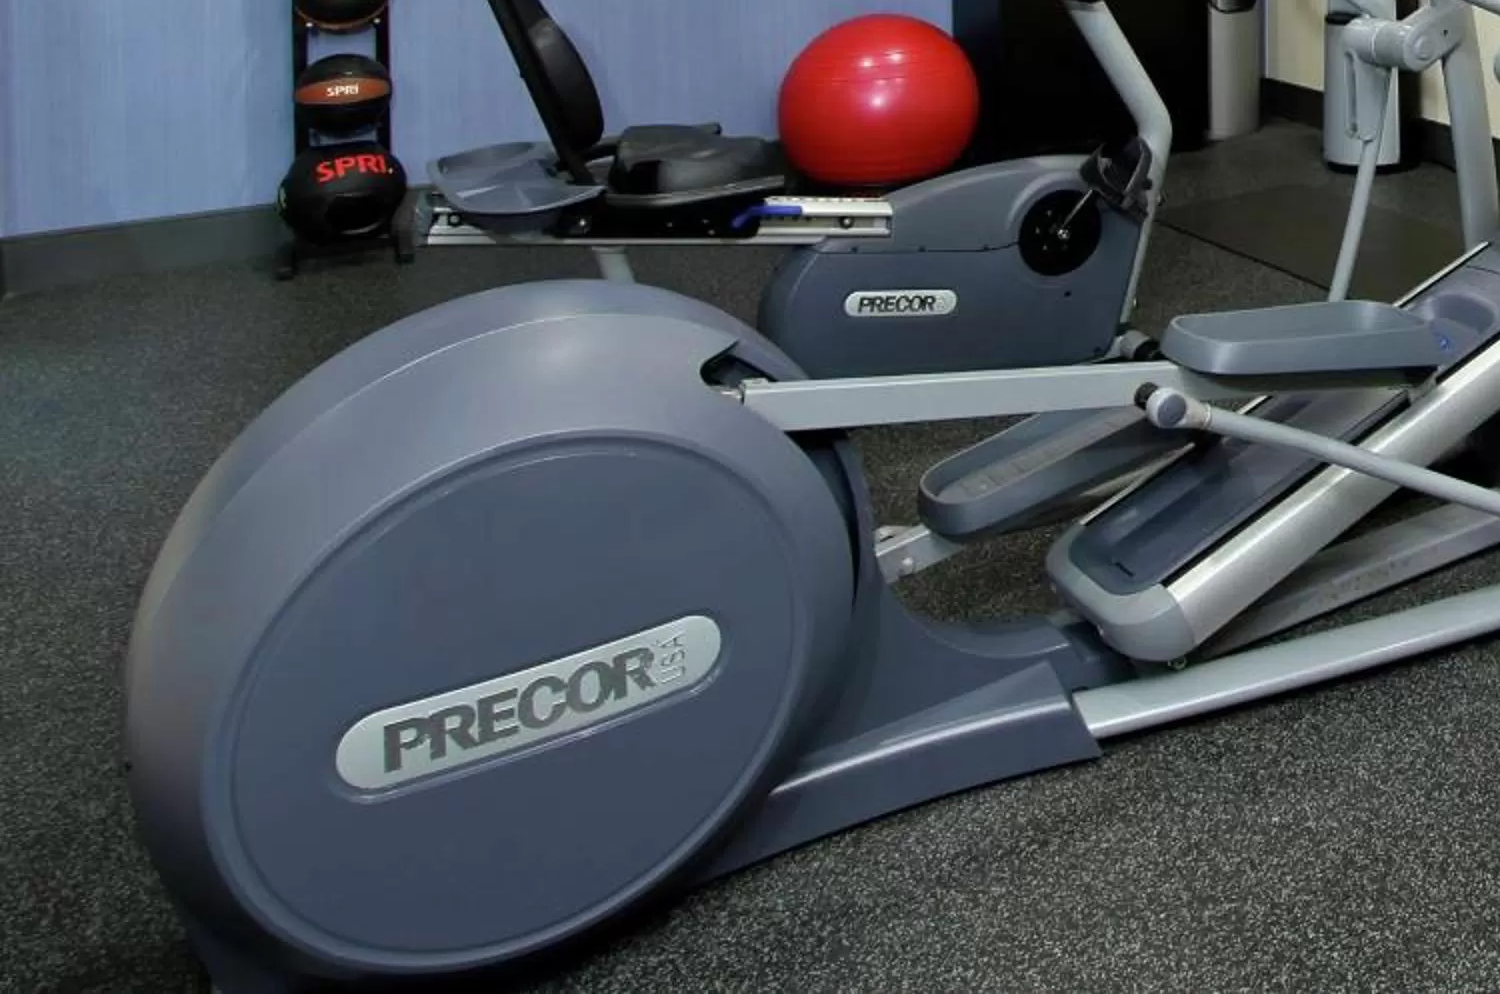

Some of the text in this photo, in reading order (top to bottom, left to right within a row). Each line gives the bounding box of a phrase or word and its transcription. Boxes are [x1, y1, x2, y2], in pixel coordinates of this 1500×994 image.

[326, 84, 360, 97] SPRI
[316, 154, 387, 183] SPRI
[858, 295, 936, 313] PRECOR
[383, 647, 655, 773] PRECOR
